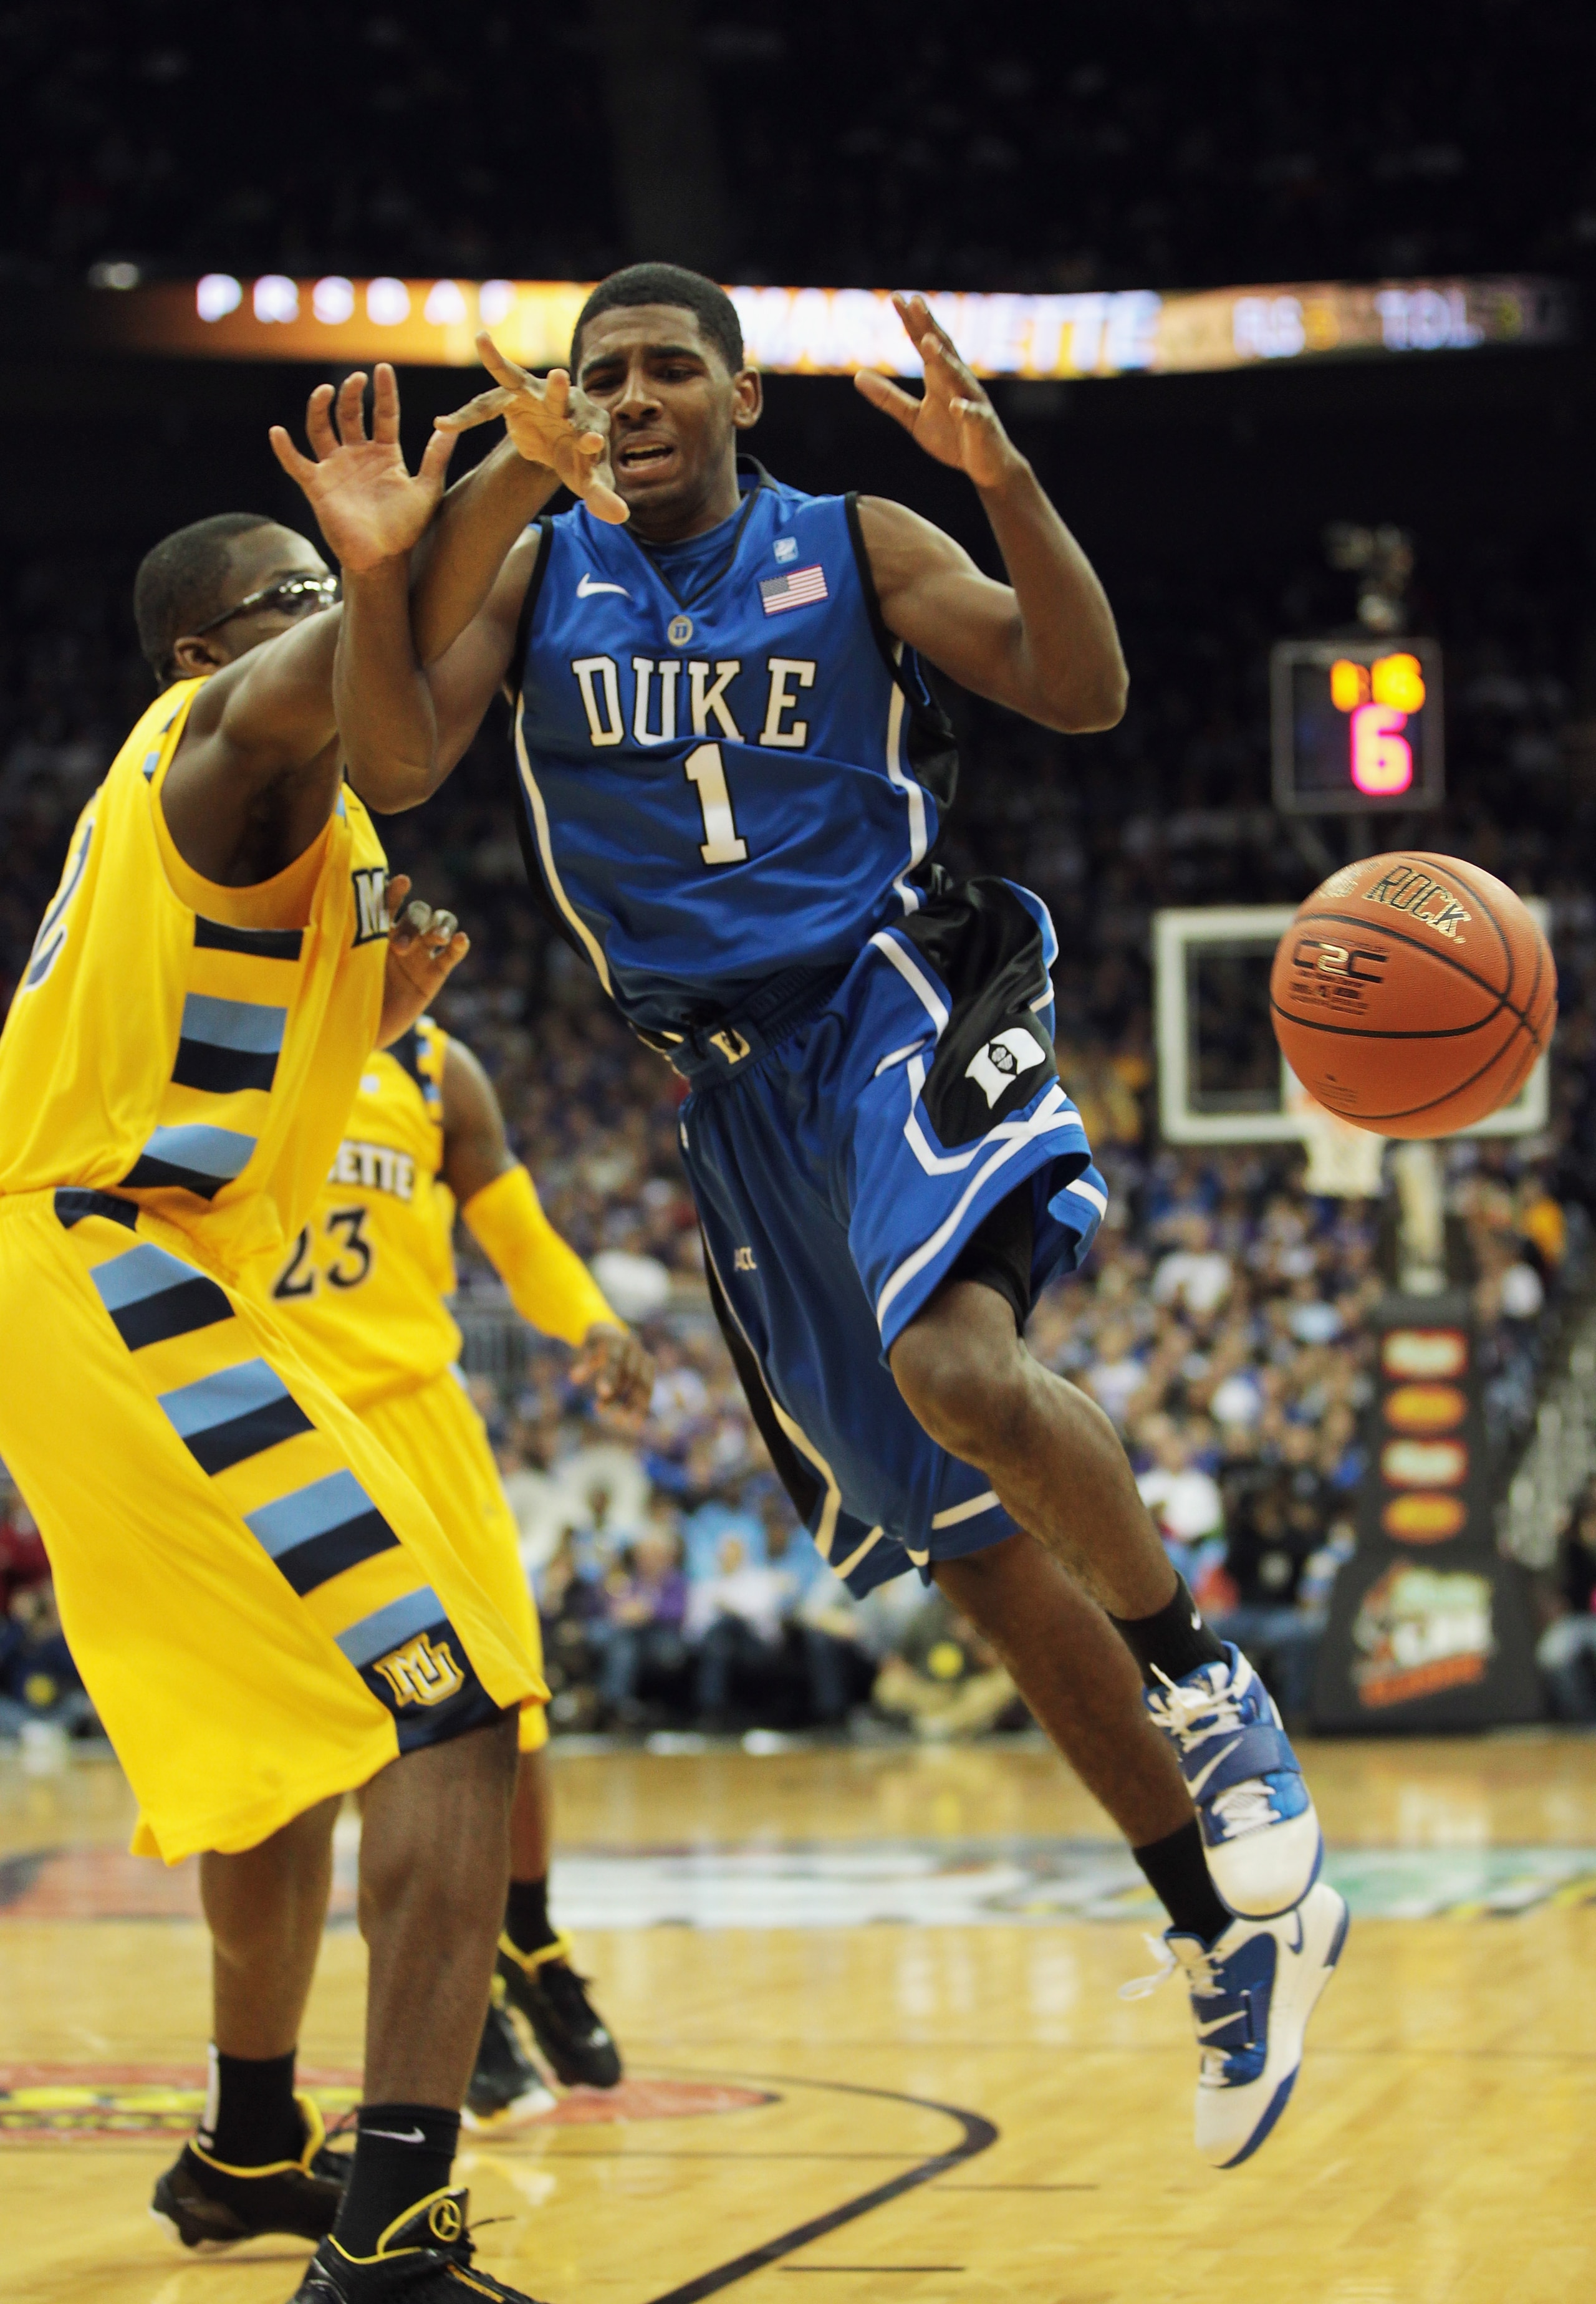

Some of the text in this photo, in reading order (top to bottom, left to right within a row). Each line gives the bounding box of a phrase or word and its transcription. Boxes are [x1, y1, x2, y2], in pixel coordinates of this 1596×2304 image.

[571, 656, 817, 749] DUKE
[1350, 702, 1413, 796] 6
[683, 742, 750, 865] 1
[272, 1204, 373, 1300] 23
[373, 1631, 465, 1707] MU
